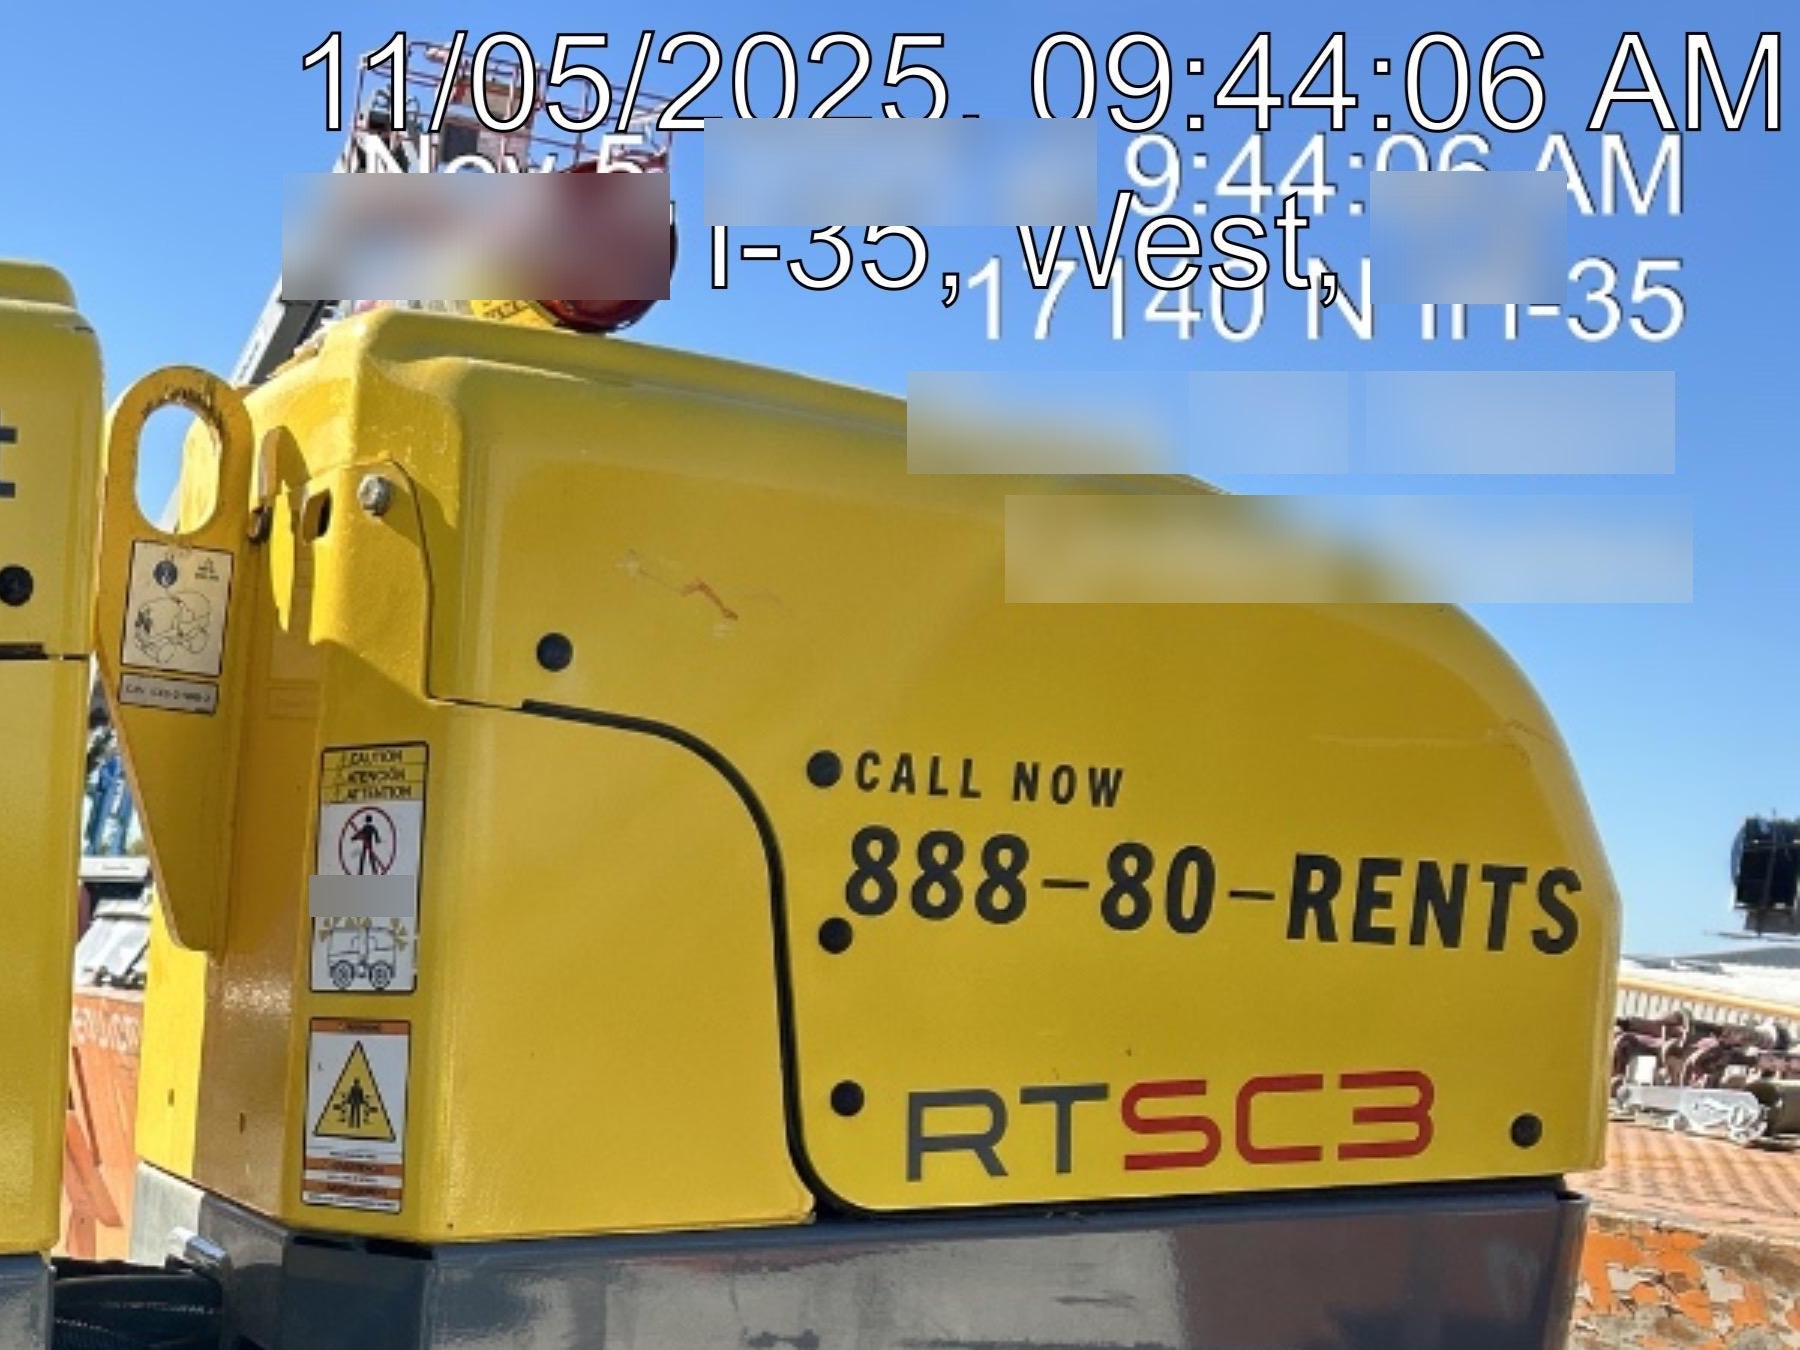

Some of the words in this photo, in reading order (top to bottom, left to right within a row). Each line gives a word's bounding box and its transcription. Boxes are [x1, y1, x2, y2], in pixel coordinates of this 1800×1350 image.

[855, 751, 982, 799] CALL
[1012, 760, 1125, 808] NOW
[844, 825, 1582, 954] 888-80-RENTS
[905, 1070, 1435, 1182] RTSC3
